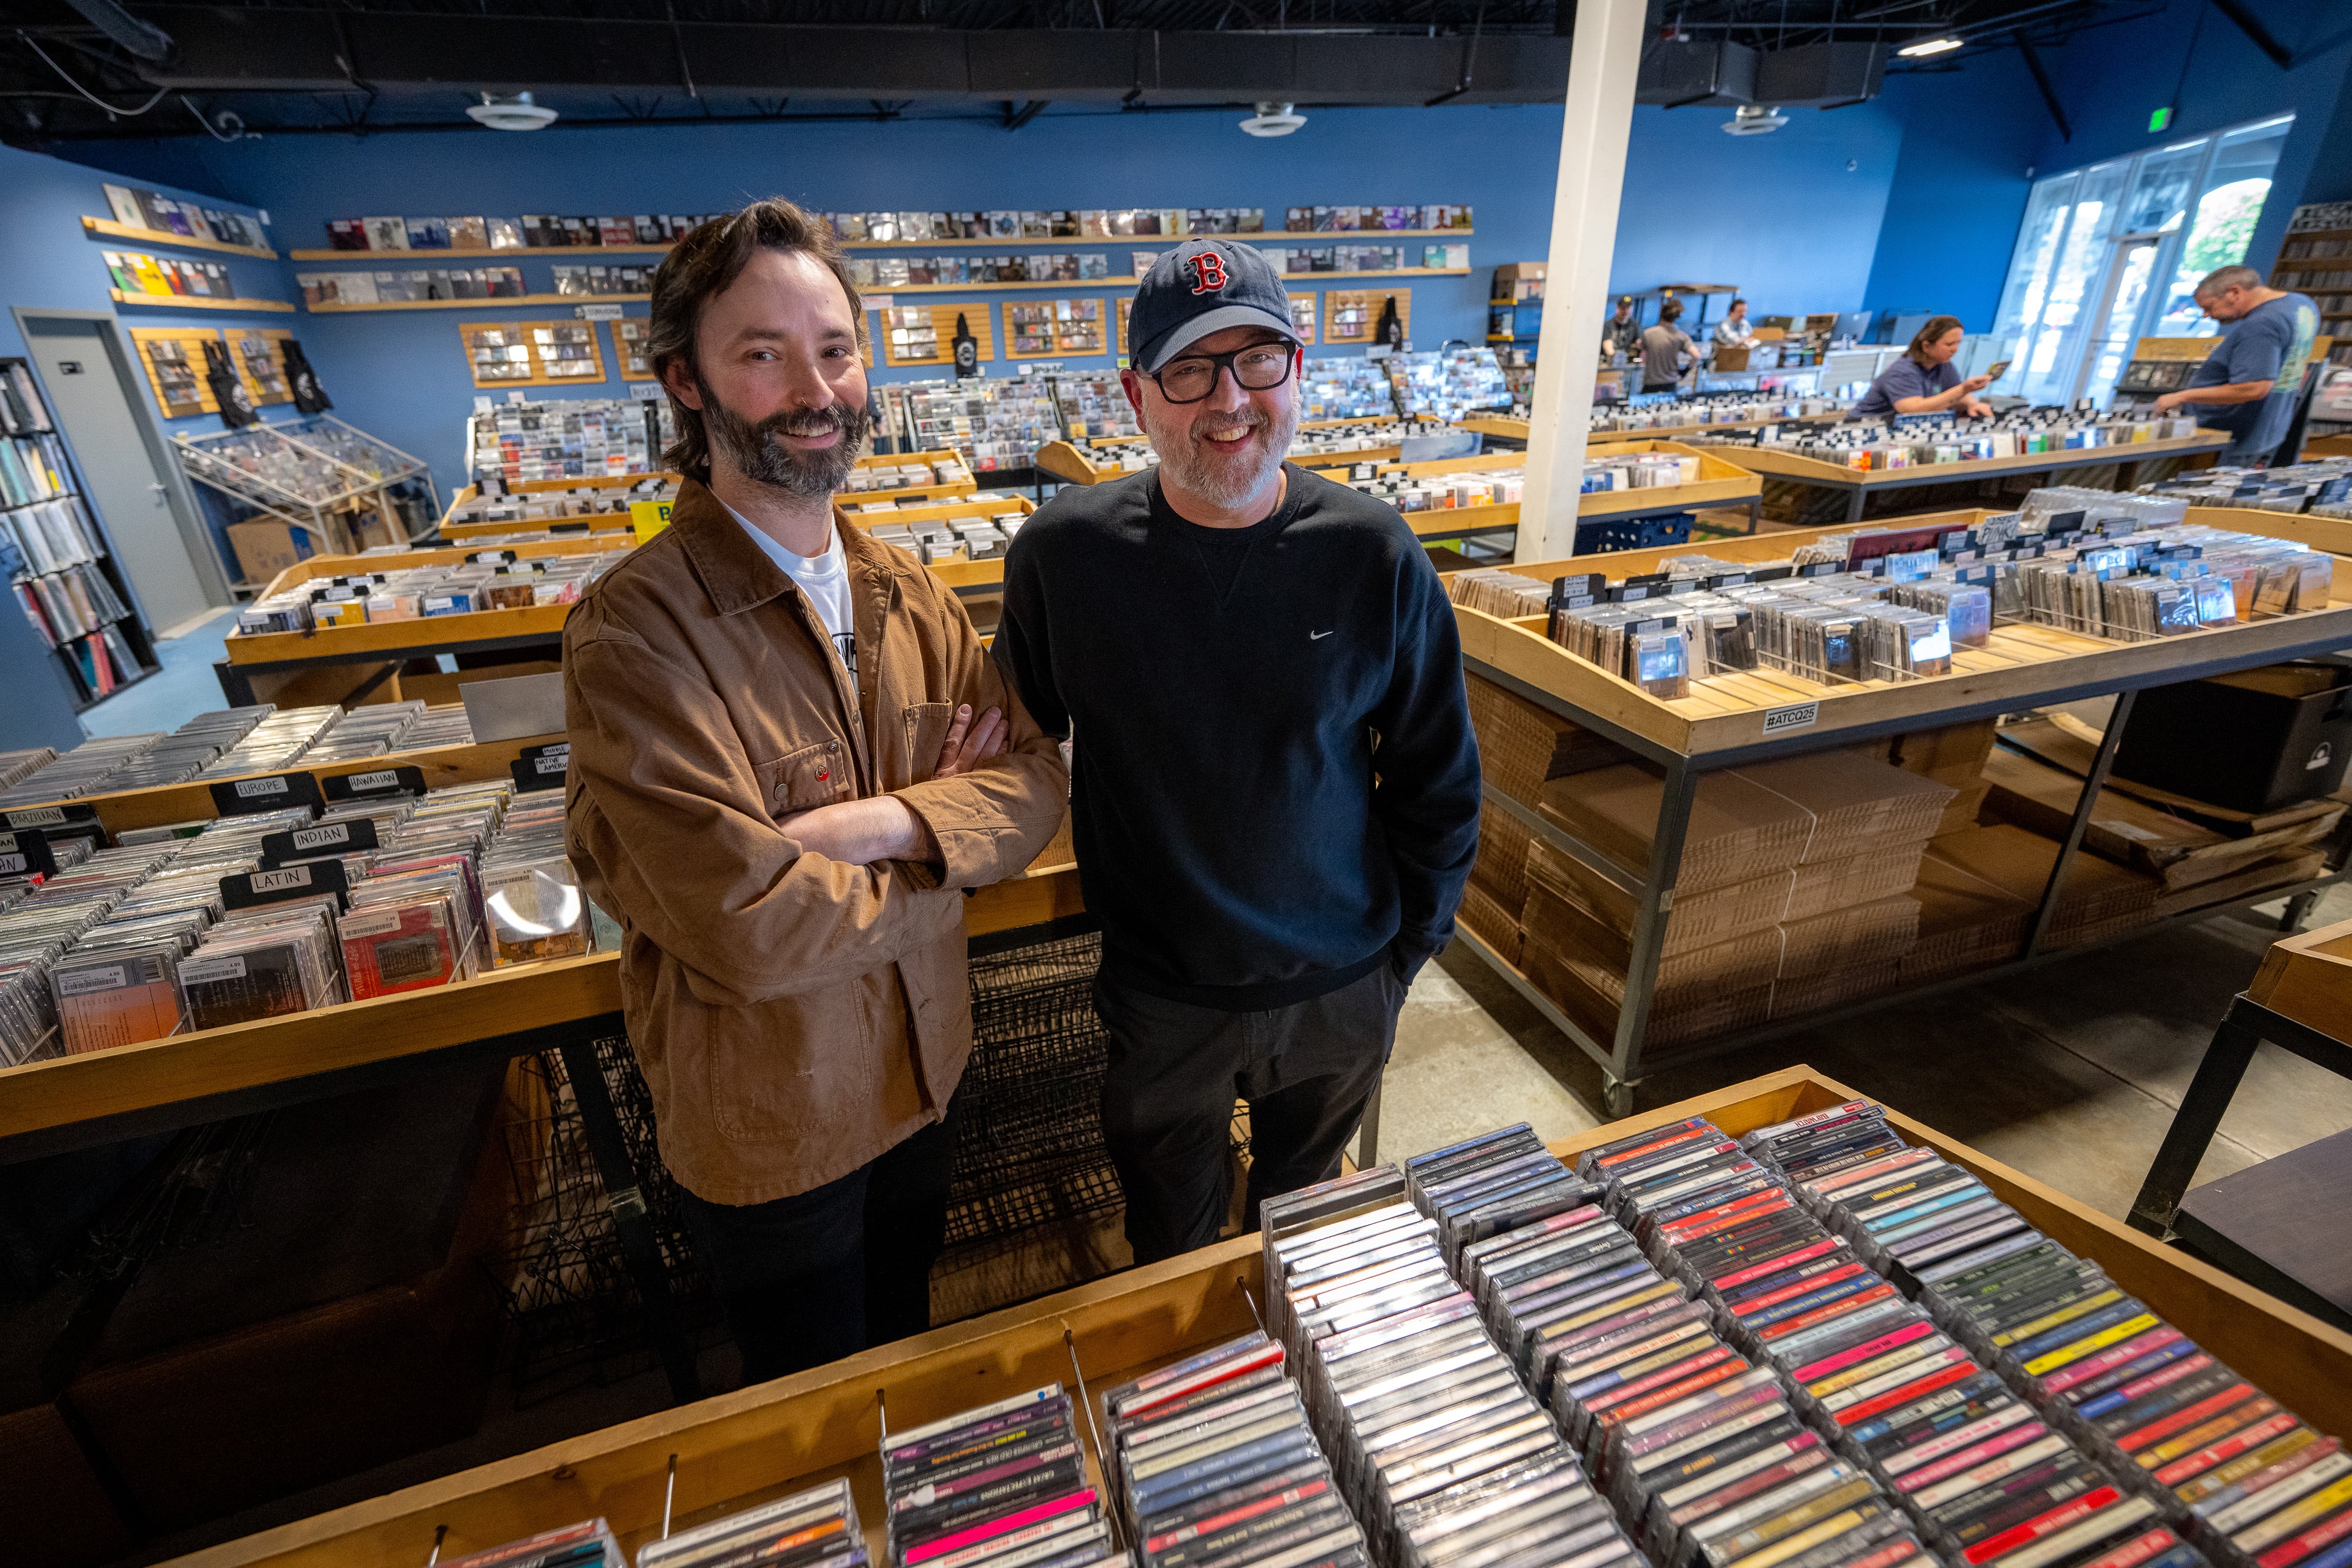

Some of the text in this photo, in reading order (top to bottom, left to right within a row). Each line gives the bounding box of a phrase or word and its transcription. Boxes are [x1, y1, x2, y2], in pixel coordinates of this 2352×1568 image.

[1187, 251, 1230, 295] B
[1766, 708, 1815, 727] #ATCQ25
[543, 746, 565, 755] MIDDLE
[535, 757, 559, 765] NATIVE
[239, 780, 282, 794] EUROPE
[350, 771, 395, 788] HAWAIIAN
[10, 810, 62, 824] BRAZILIAN
[296, 828, 342, 846] INDIAN
[254, 870, 300, 889] LATIN
[1795, 1112, 1829, 1128] BAYWATCH
[1031, 1469, 1055, 1483] GREAT
[979, 1476, 1033, 1500] EXPECTATIONS
